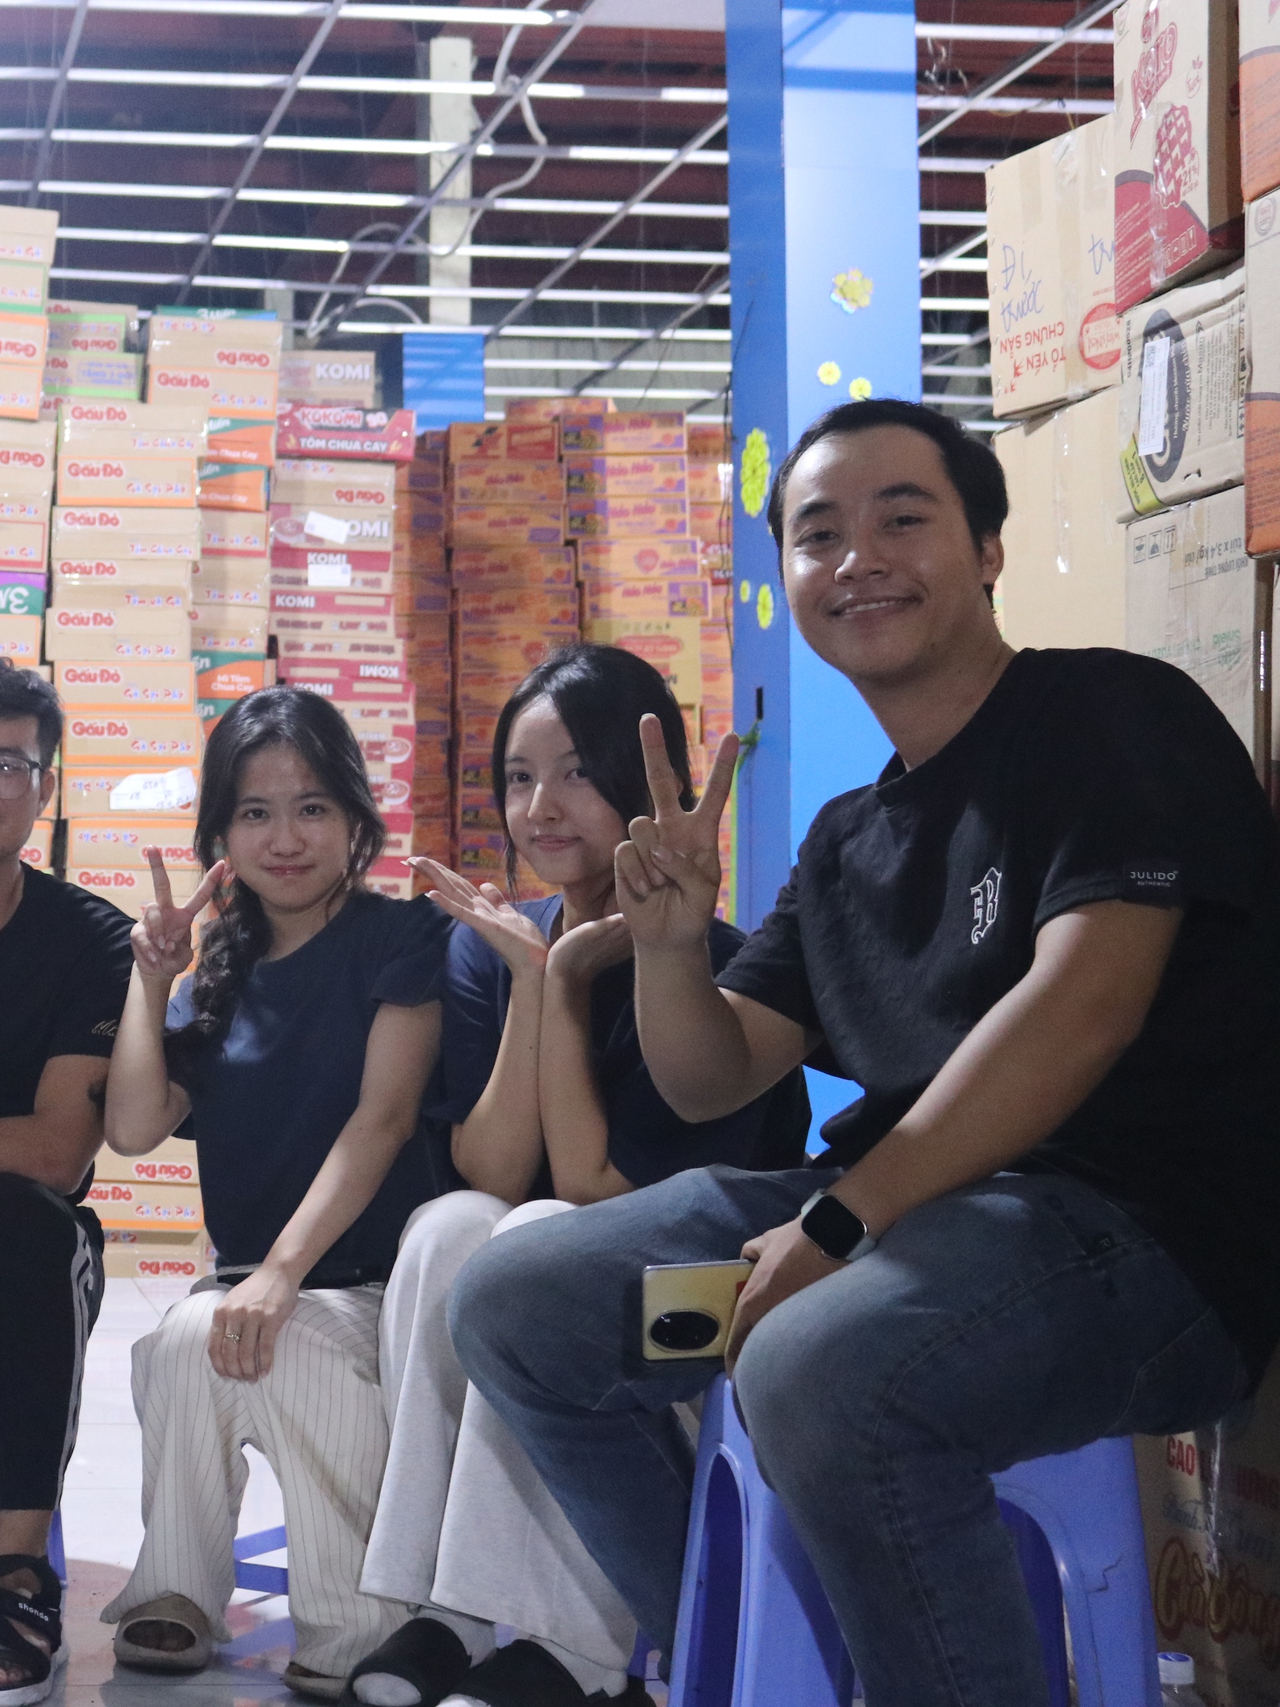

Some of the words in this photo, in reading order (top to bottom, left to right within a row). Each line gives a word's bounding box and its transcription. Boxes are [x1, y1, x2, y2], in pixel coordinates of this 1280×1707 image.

[316, 363, 370, 380] KOMI
[300, 436, 326, 449] TÔM
[328, 439, 361, 450] CHUA
[364, 441, 388, 452] CAY
[276, 595, 315, 608] KOMI
[360, 665, 399, 678] KOMI
[1129, 870, 1176, 881] JULIDO
[1166, 1436, 1196, 1476] CAO
[18, 1602, 49, 1622] shondo
